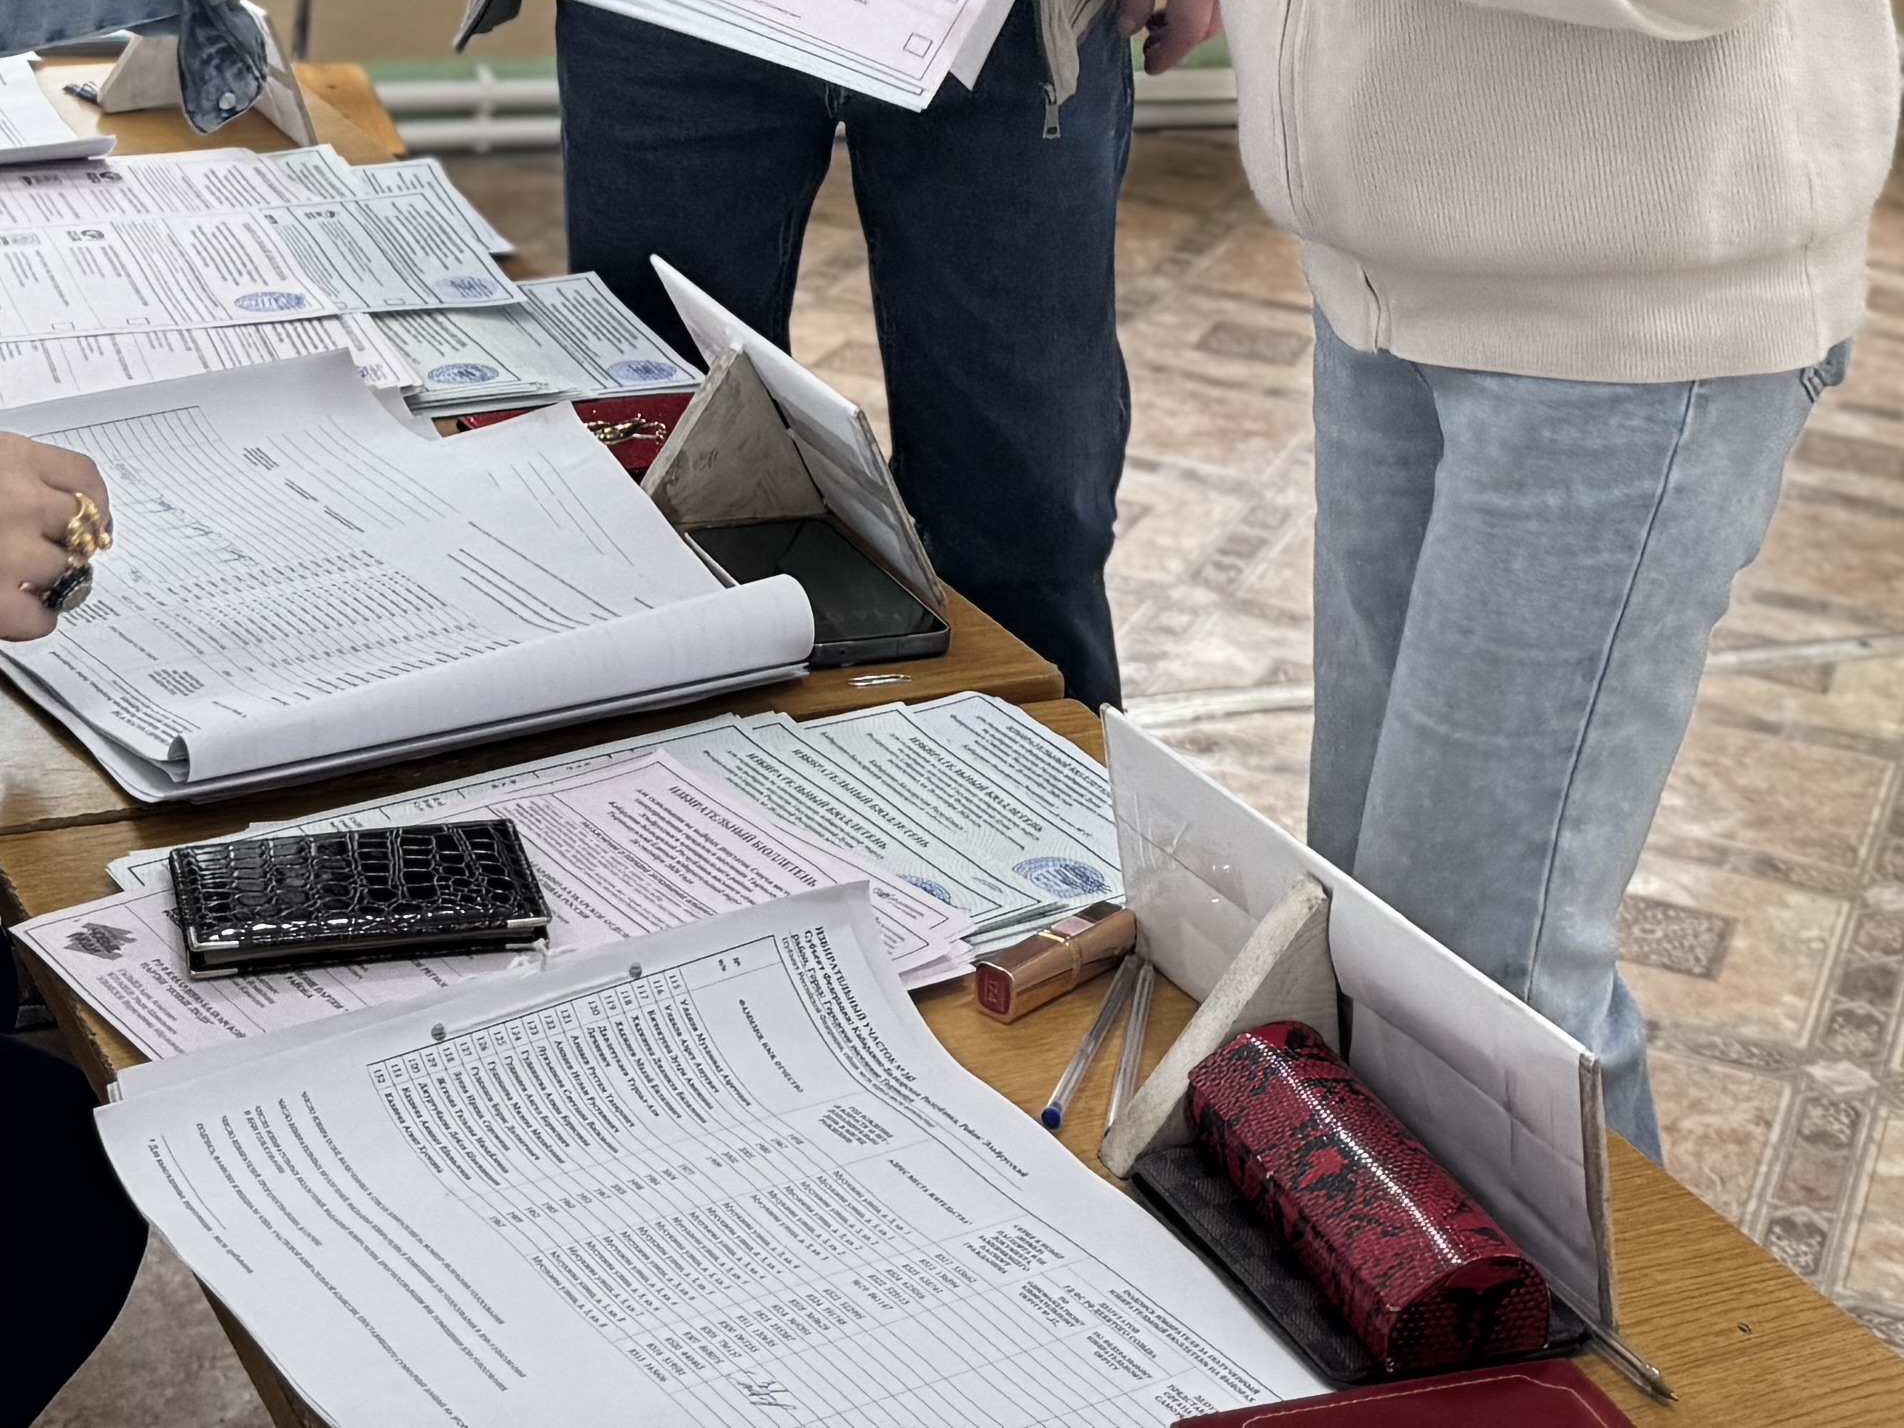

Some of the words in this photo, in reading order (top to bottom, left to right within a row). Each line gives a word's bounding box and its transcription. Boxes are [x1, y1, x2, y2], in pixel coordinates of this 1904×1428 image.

[908, 736, 989, 791] ИЗБИРАТЕЛЬНЫЙ
[745, 752, 829, 808] ИЗБИРАТЕЛЬНЫЙ
[791, 748, 873, 804] ИЗБИРАТЕЛЬНЫЙ
[668, 785, 756, 842] ИЗБИРАТЕЛЬНЫЙ
[751, 840, 816, 887] БЮЛЛЕТЕНЬ
[804, 929, 825, 970] Субъект
[652, 979, 665, 995] 116
[668, 974, 681, 990] 115
[636, 984, 649, 999] 117
[814, 926, 866, 1020] ИЗБИРАТЕЛЬНЫЙ
[862, 1021, 897, 1064] УЧАСТОК
[587, 1000, 601, 1016] 120
[603, 994, 617, 1010] 119
[543, 1014, 556, 1030] 122
[559, 1008, 572, 1024] 121
[509, 1025, 522, 1041] 124
[526, 1019, 539, 1036] 123
[475, 1035, 488, 1052] 126
[492, 1030, 507, 1046] 125
[459, 1041, 472, 1056] 127
